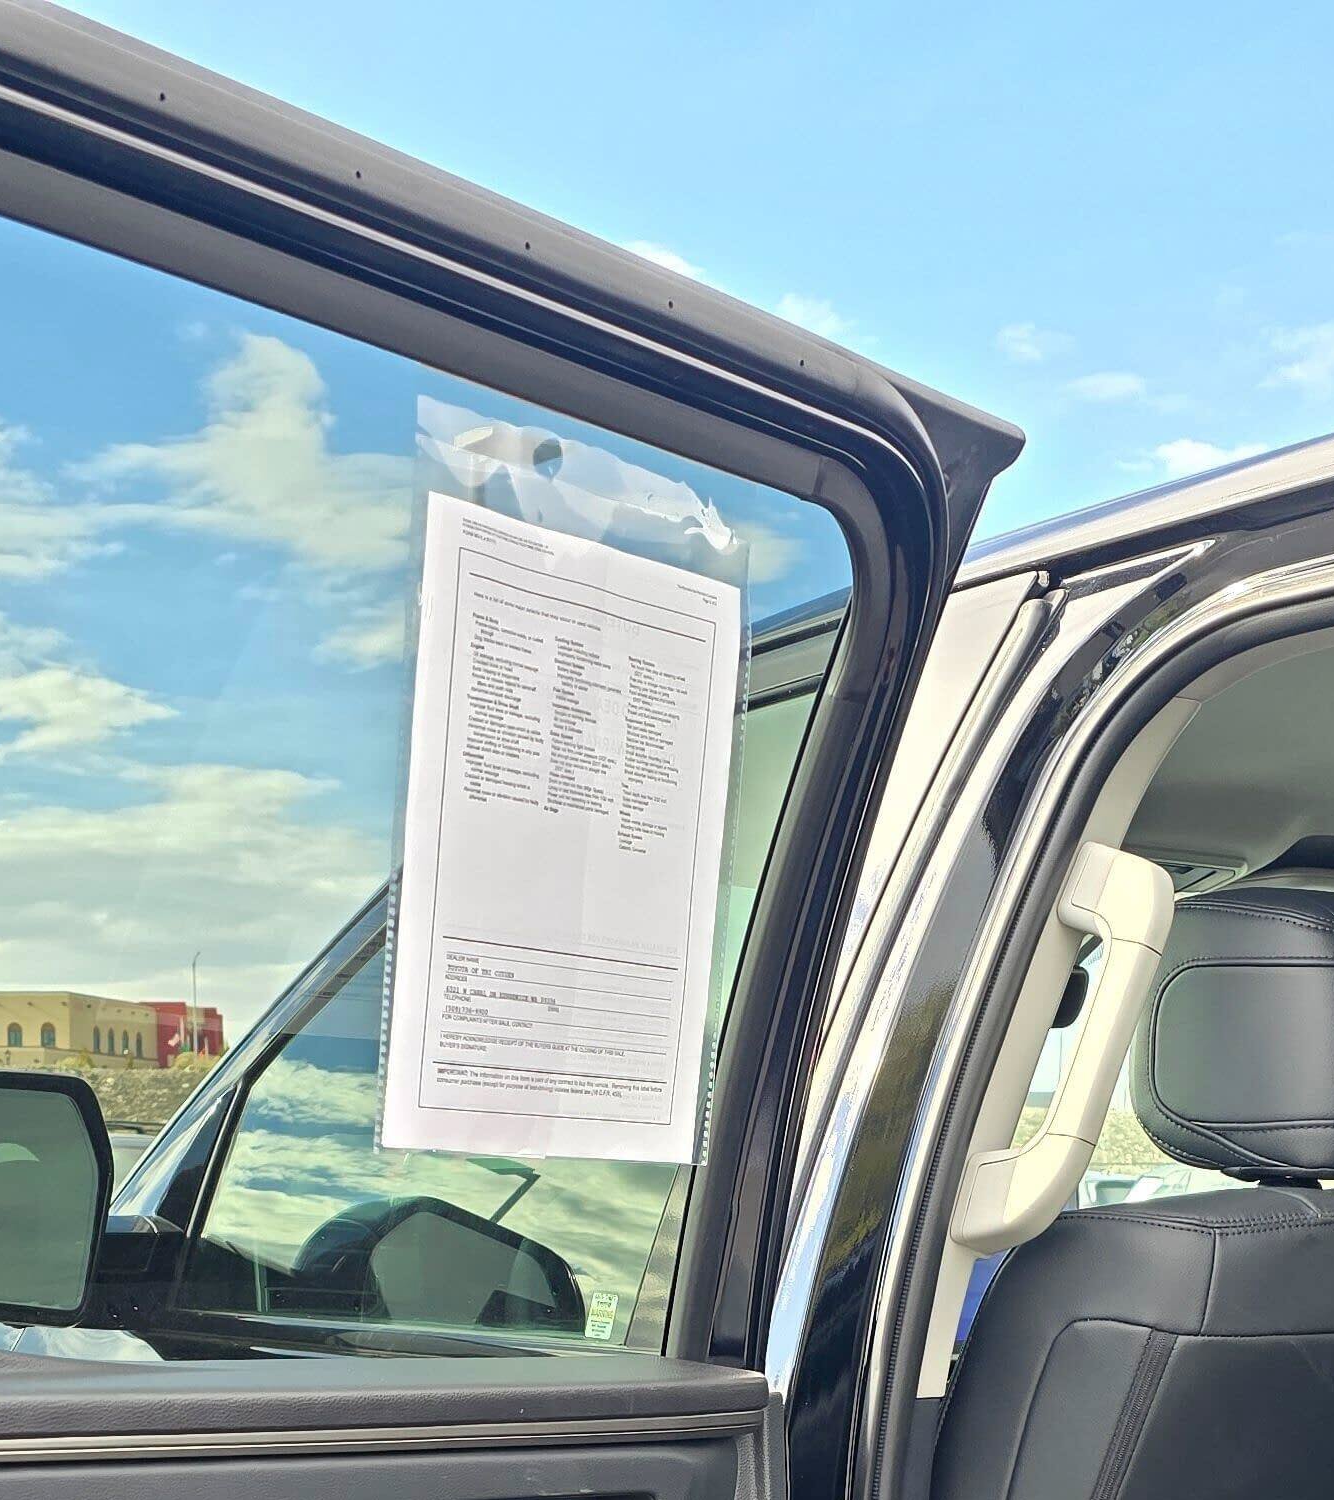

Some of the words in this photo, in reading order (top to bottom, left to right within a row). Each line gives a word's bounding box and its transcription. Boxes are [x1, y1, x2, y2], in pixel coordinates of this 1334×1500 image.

[447, 964, 468, 973] TOYOTA
[443, 993, 471, 1002] TELEPHONE
[453, 1015, 482, 1023] COMPLAINTS
[462, 1035, 498, 1044] ACKNOWLEDGE
[479, 1071, 503, 1079] information
[436, 1076, 458, 1084] consumer
[460, 1078, 481, 1086] purchase
